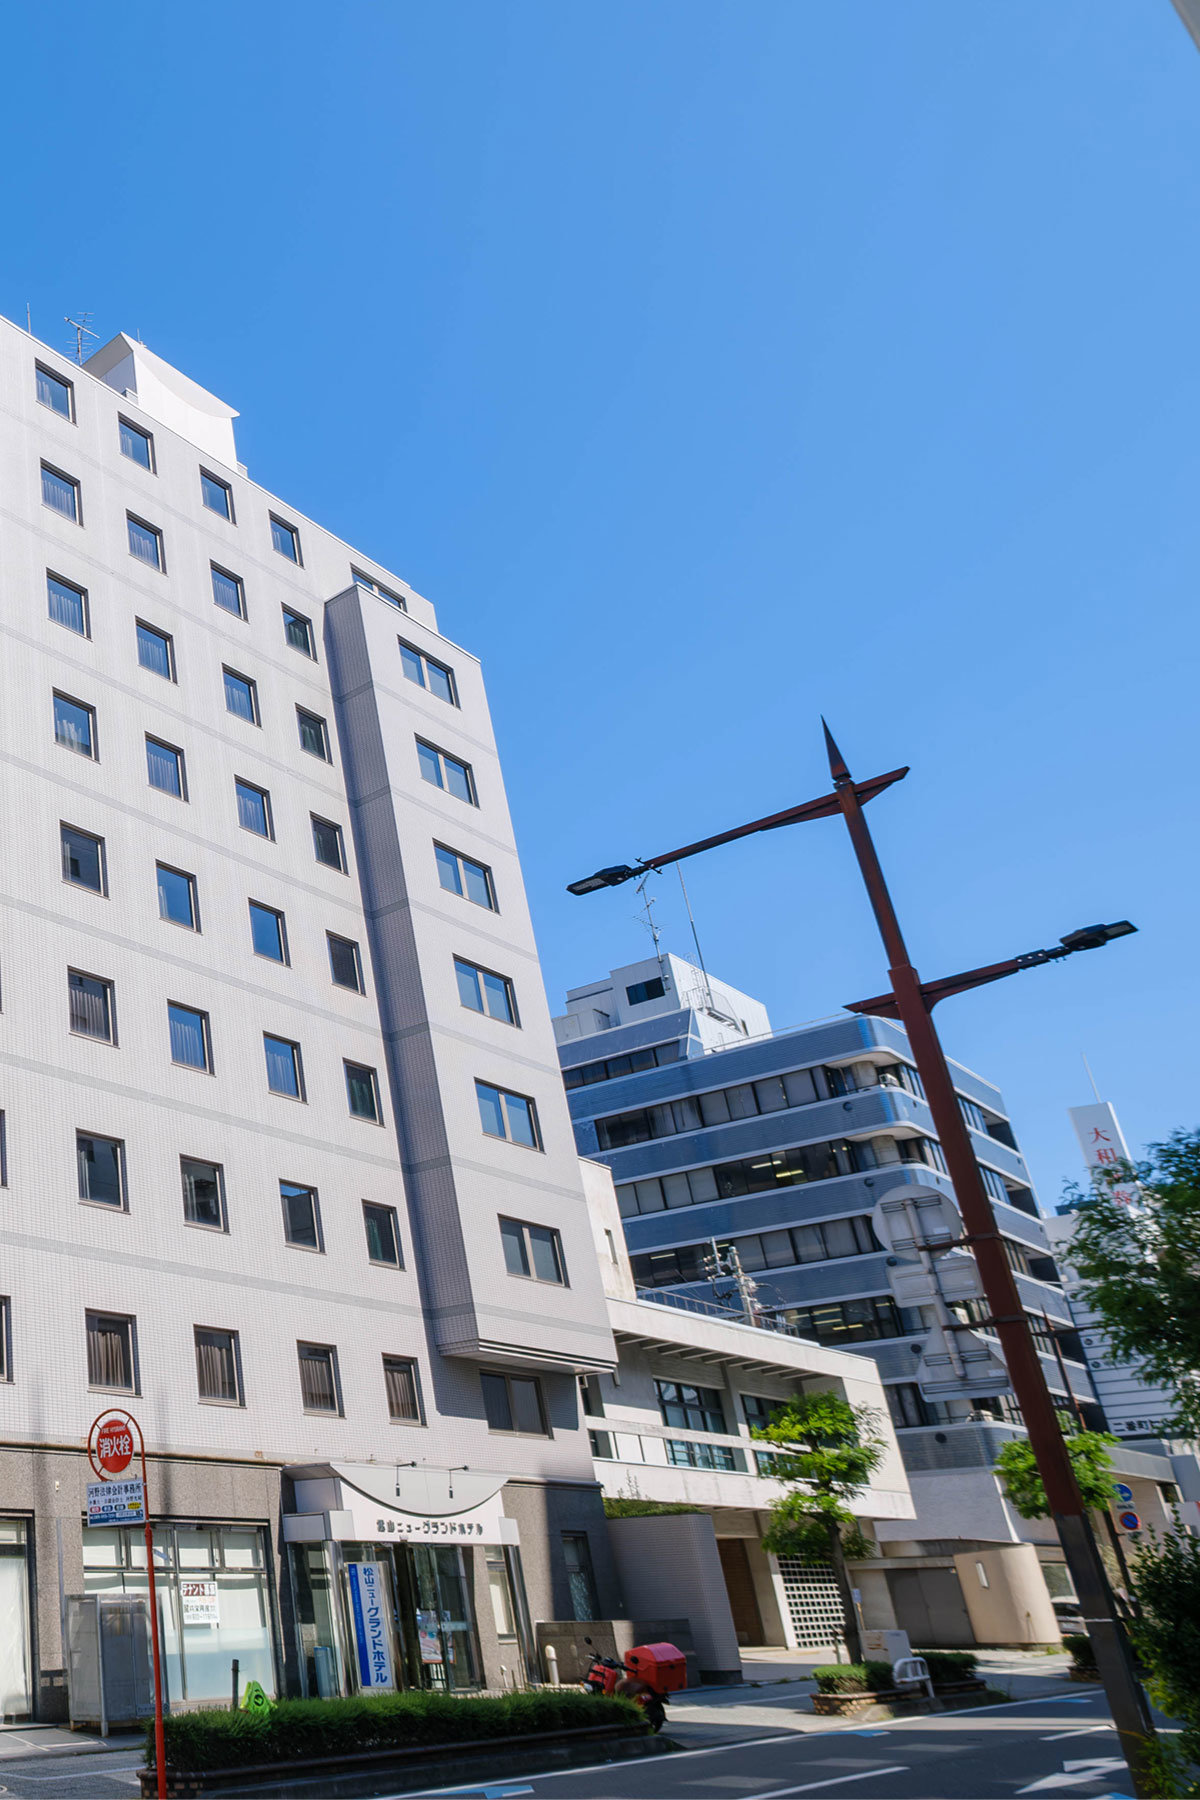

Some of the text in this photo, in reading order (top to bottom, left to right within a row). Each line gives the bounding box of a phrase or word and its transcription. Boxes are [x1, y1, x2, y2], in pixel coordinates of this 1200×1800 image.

[1088, 1127, 1132, 1205] 大和券
[100, 1435, 131, 1458] 消火栓
[377, 1520, 483, 1536] 松山ニューグランドホテル
[363, 1567, 388, 1683] 松山ニューグランドホテル
